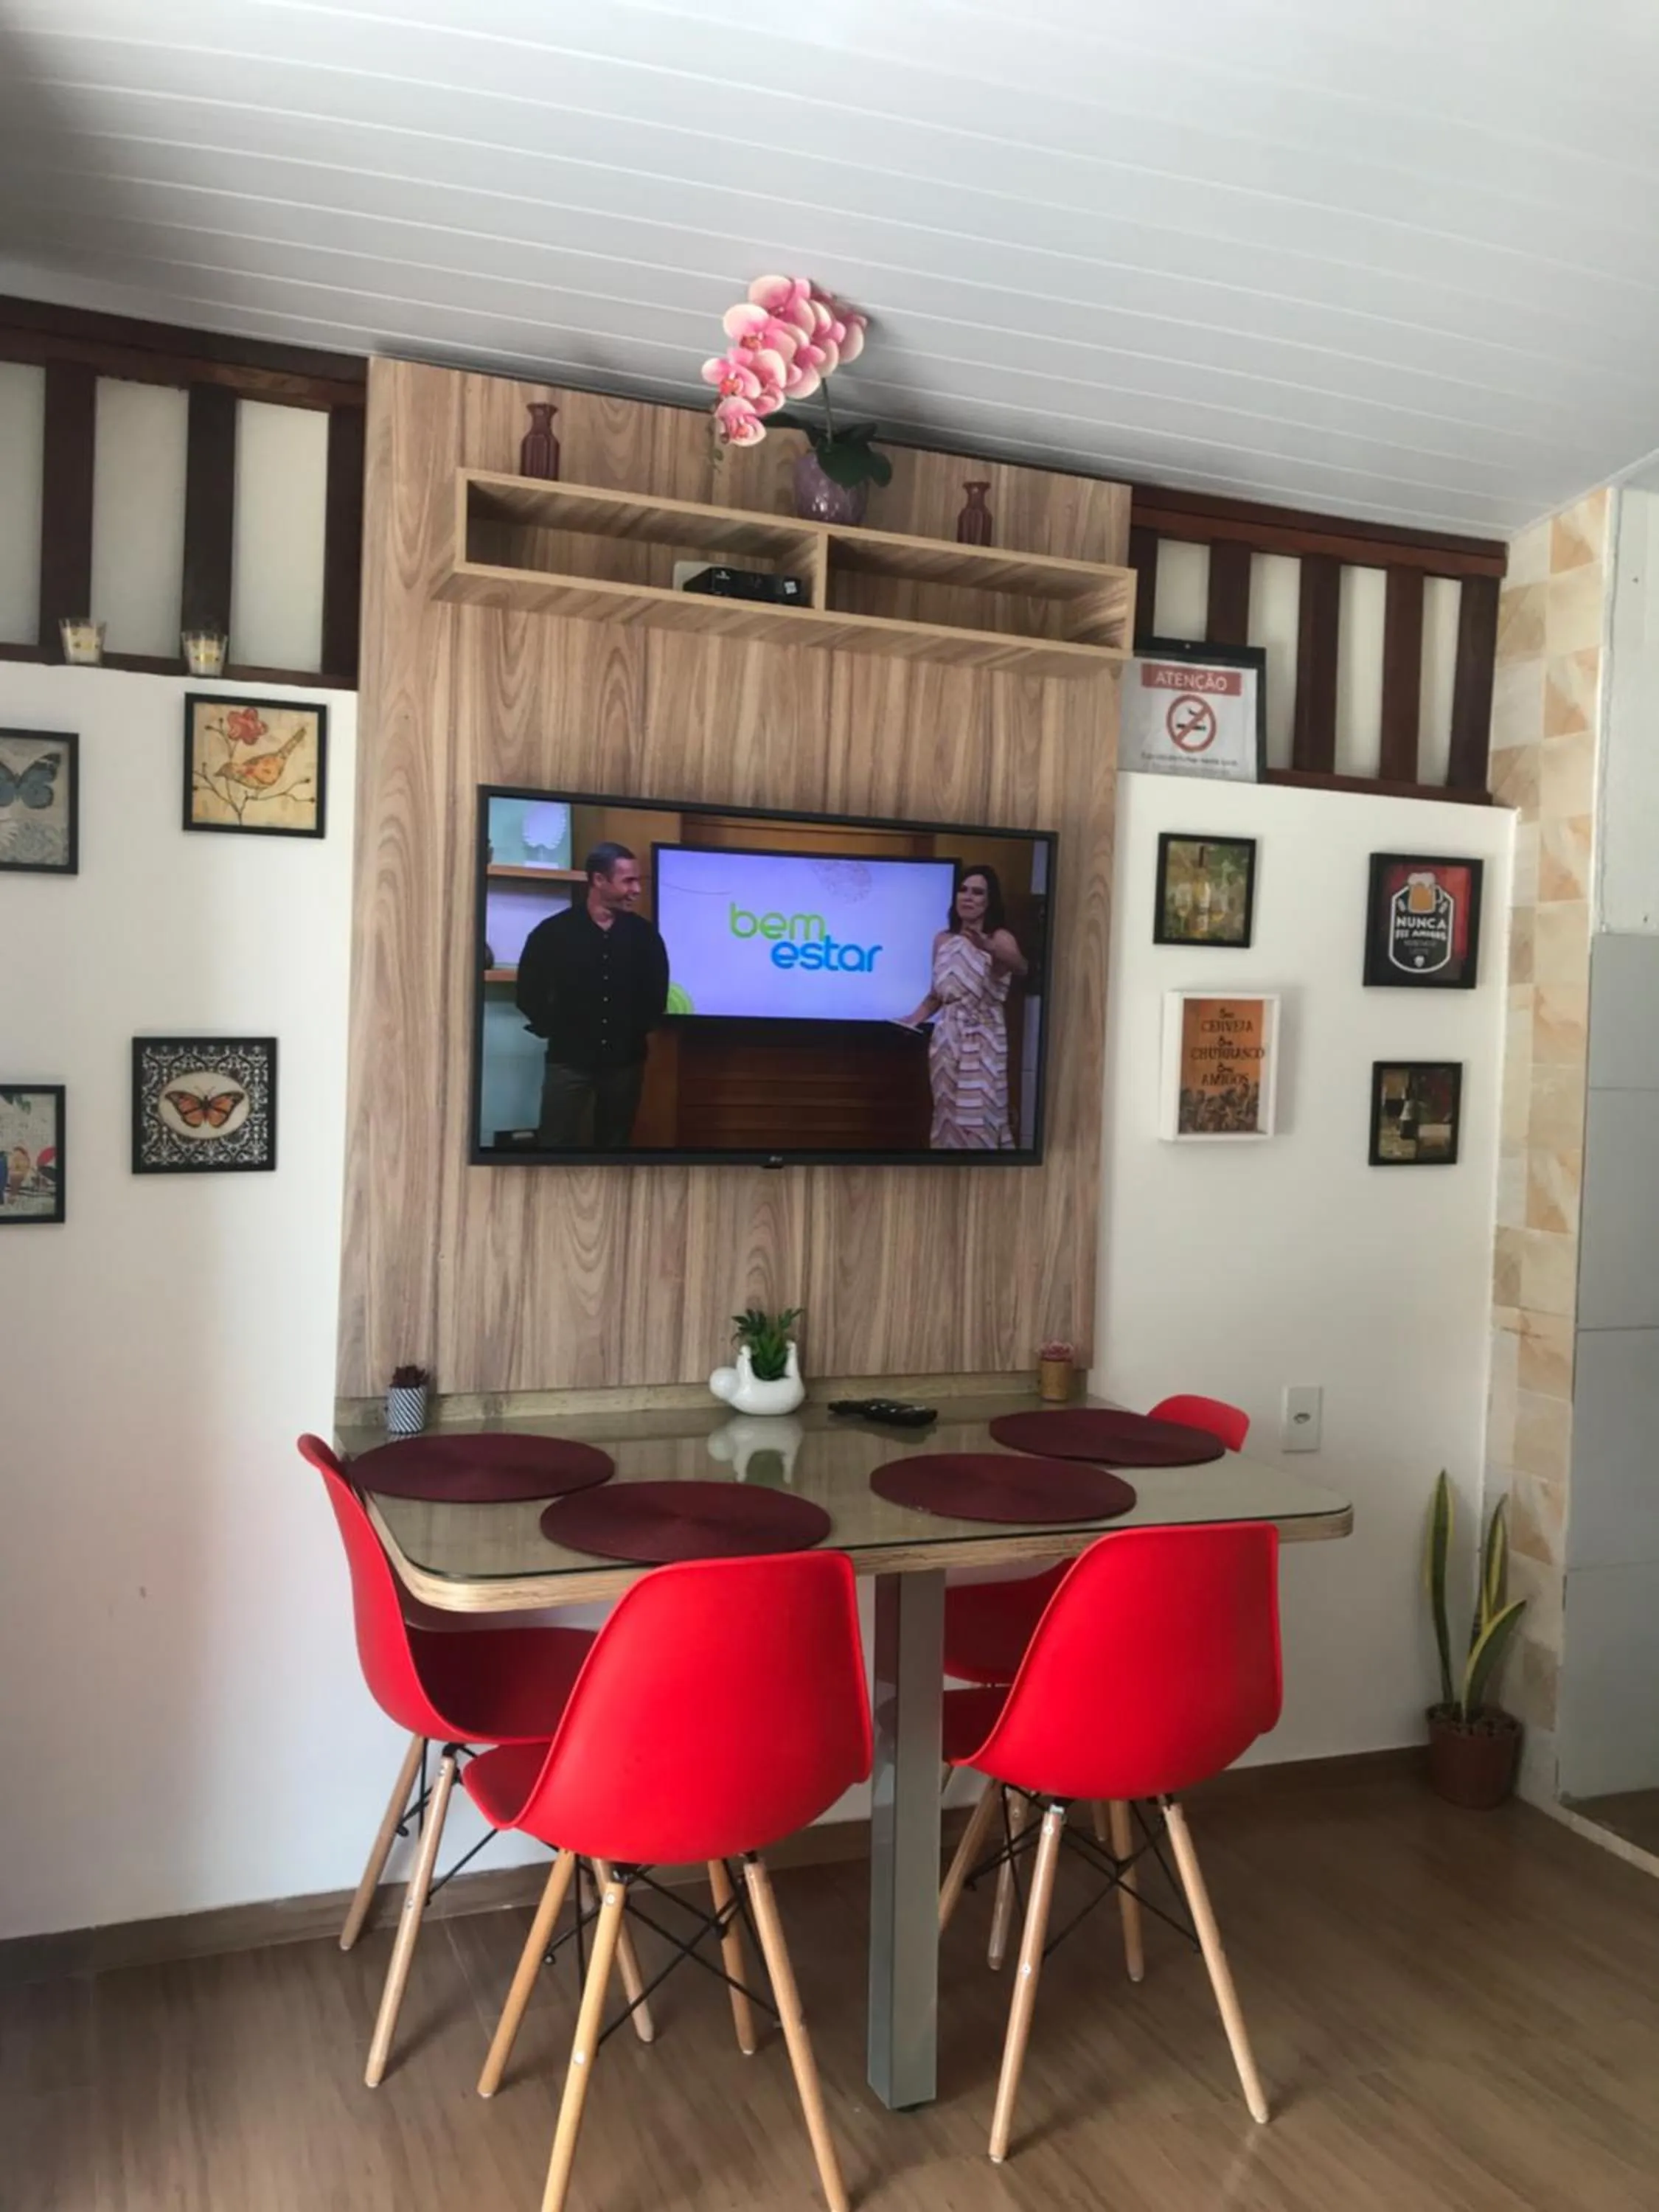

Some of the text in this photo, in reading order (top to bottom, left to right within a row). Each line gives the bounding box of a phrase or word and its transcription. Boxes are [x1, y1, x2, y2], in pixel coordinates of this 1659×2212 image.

[1155, 671, 1228, 691] ATENÇÃO
[730, 902, 825, 941] bem
[1397, 917, 1446, 929] NUNCA
[771, 934, 883, 973] estar
